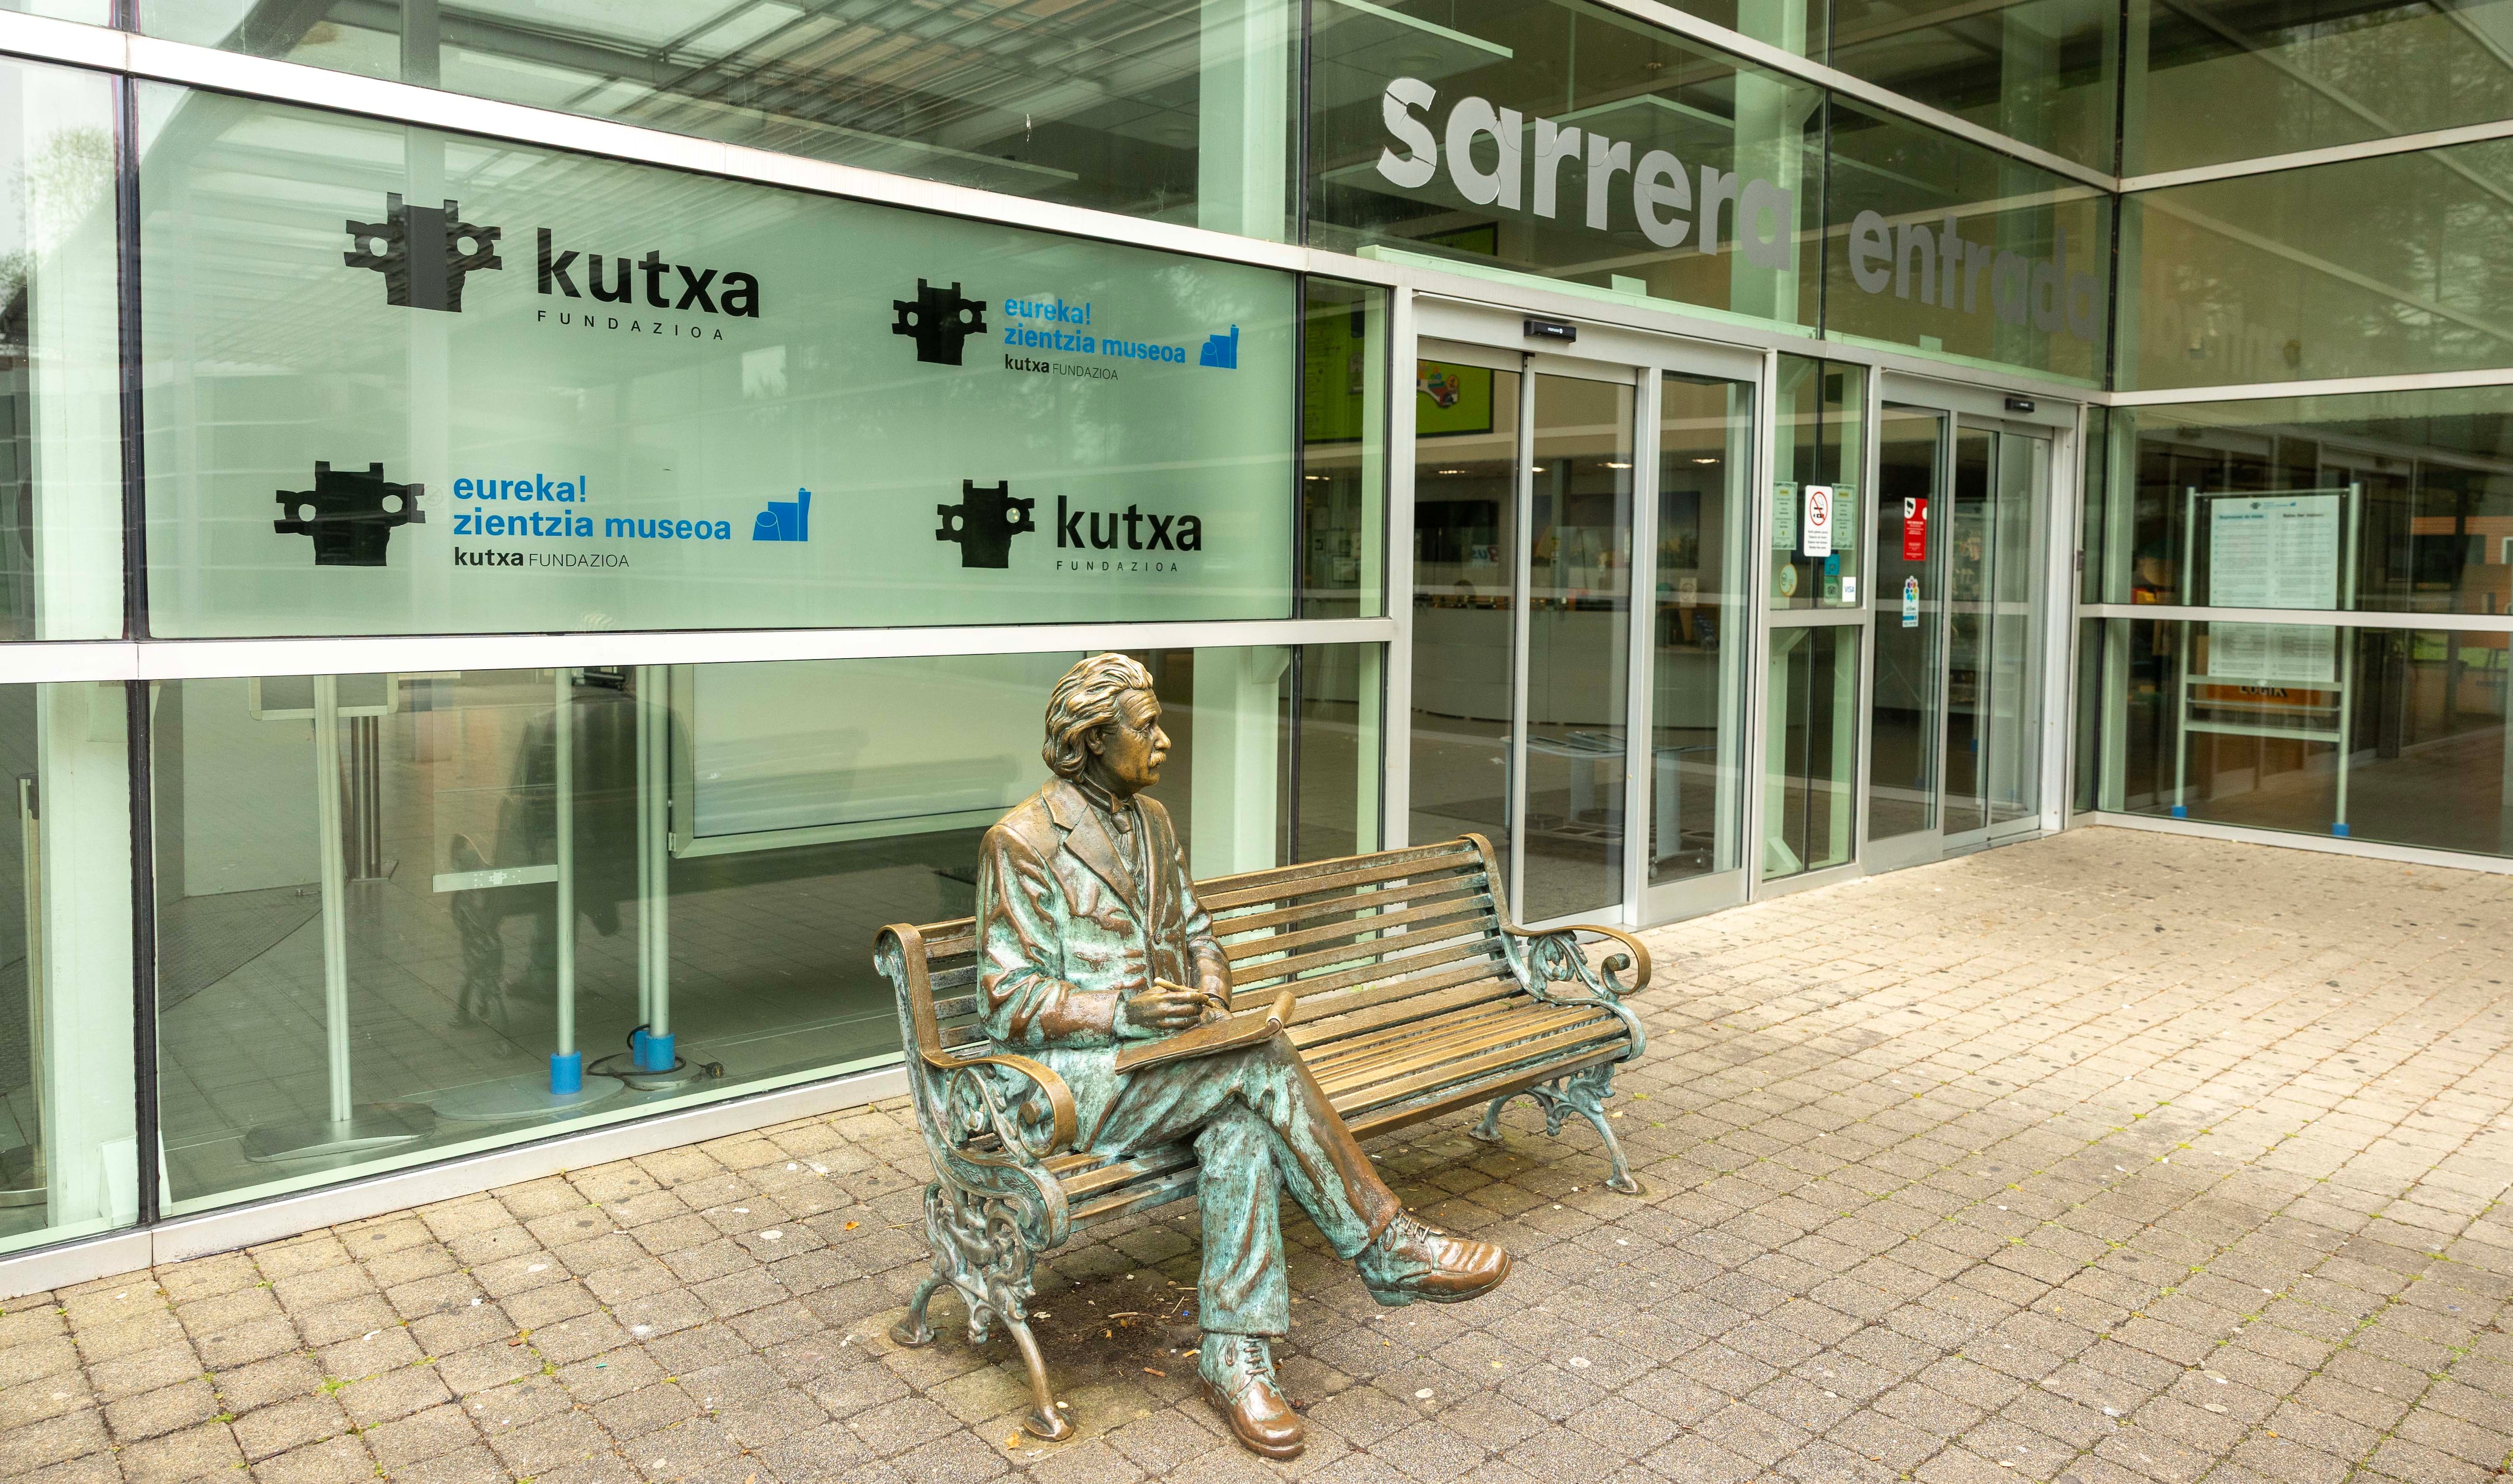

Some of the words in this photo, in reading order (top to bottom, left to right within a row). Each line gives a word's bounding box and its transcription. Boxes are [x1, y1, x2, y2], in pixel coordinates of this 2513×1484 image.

[1376, 76, 1792, 272] sarrera
[538, 228, 759, 319] kutxa
[1848, 210, 2101, 342] entrada
[538, 310, 723, 340] FUNDAZIOA
[1005, 299, 1090, 325] eureka!
[1005, 323, 1095, 353] zientzia
[1102, 339, 1185, 364] museoa
[1005, 354, 1049, 373] kutxa
[1053, 362, 1118, 380] FUNDAZIOA
[453, 473, 587, 503] eureka!
[453, 507, 594, 538] zientzia
[605, 518, 731, 540] museoa
[1057, 495, 1201, 551] kutxa
[454, 546, 524, 566] kutxa
[529, 553, 629, 567] FUNDAZIOA
[1057, 561, 1177, 572] FUNDAZIOA
